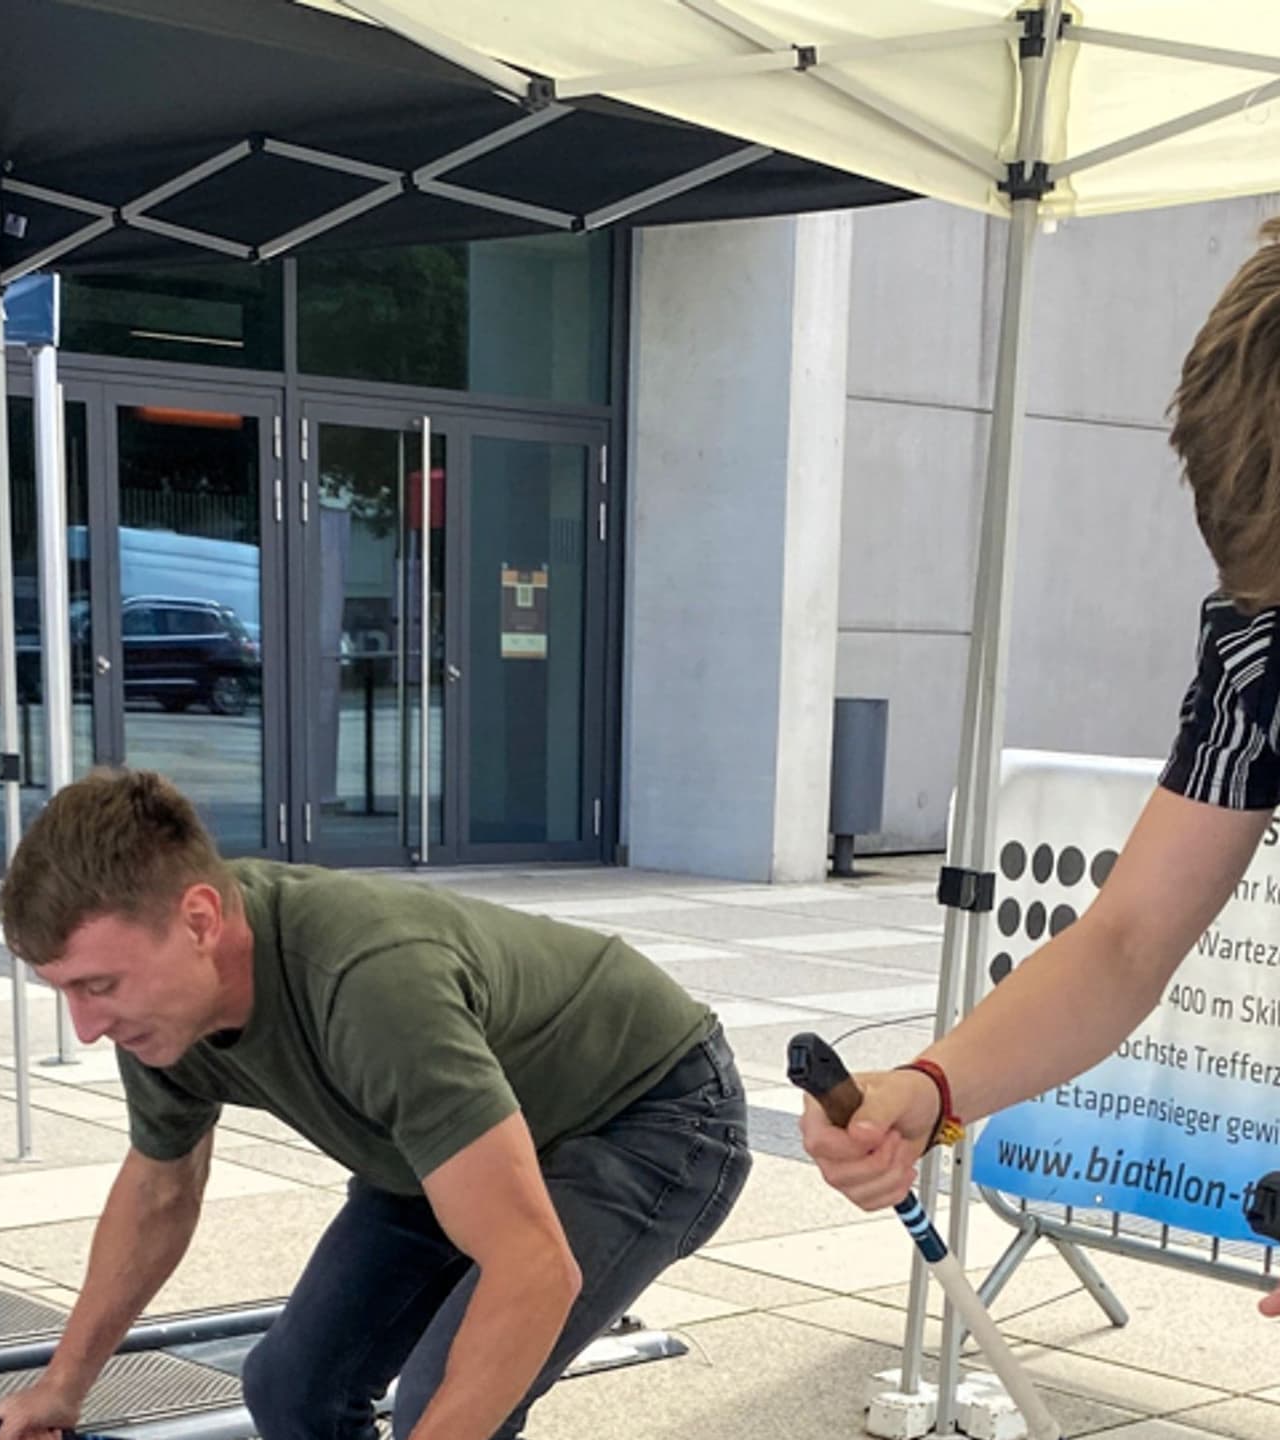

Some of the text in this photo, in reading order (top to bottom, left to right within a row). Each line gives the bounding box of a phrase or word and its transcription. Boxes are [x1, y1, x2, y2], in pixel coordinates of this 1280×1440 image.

[1168, 983, 1207, 1015] 400
[1211, 994, 1234, 1019] m
[1056, 1083, 1222, 1136] Etappensieger
